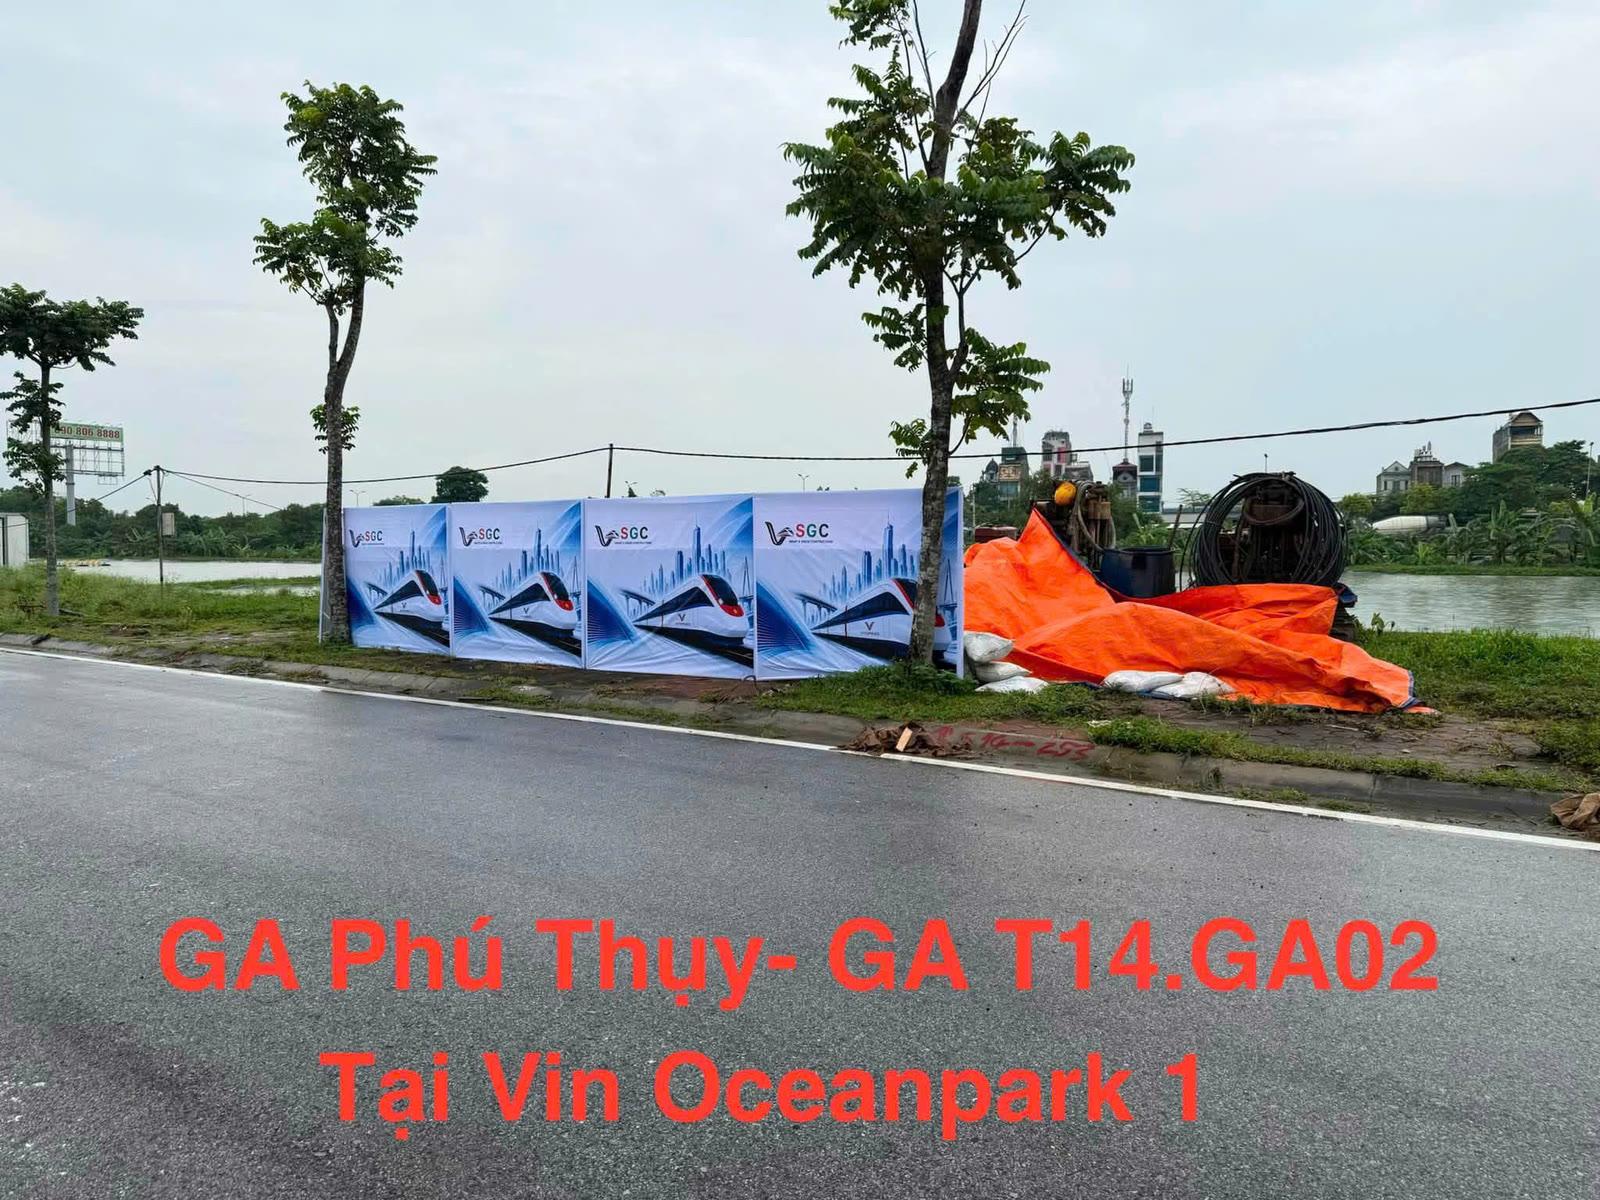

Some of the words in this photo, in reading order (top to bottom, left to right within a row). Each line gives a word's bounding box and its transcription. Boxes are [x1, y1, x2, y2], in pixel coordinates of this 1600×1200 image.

[76, 427, 93, 436] 806
[97, 429, 120, 438] 8888
[365, 530, 383, 541] SGC
[478, 528, 500, 540] SGC
[620, 526, 648, 539] SGC
[795, 523, 829, 538] SGC
